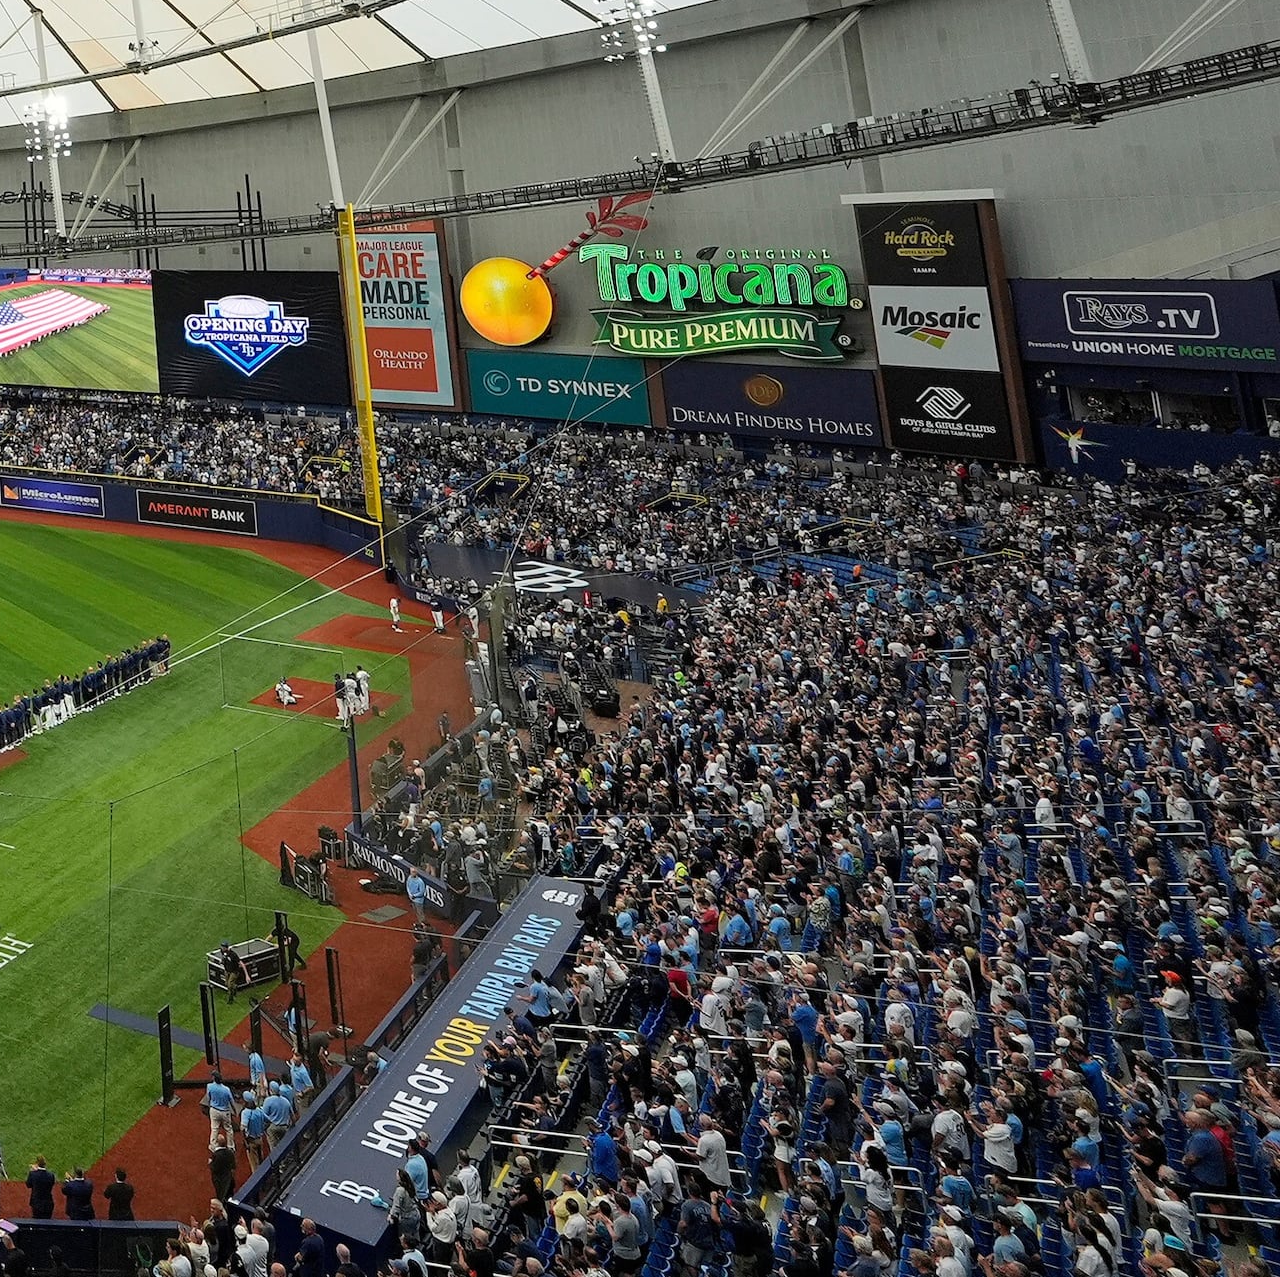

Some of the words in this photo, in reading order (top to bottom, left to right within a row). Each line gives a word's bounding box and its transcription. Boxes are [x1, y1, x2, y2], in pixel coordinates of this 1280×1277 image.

[356, 241, 387, 251] MAJOR
[390, 241, 423, 251] LEAGUE
[884, 230, 918, 245] Hard
[920, 230, 955, 246] Rock
[638, 249, 682, 260] THE
[726, 249, 832, 260] ORIGINAL
[358, 253, 427, 279] CARE
[578, 243, 849, 312] Tropicana
[361, 280, 430, 305] MADE
[363, 306, 431, 321] PERSONAL
[881, 305, 981, 329] Mosaic
[1156, 309, 1201, 329] .TV
[188, 317, 267, 332] OPENING
[270, 319, 305, 333] DAY
[610, 322, 681, 350] PURE
[685, 317, 816, 347] PREMIUM
[204, 333, 259, 342] TROPICANA
[261, 335, 288, 343] FIELD
[373, 348, 428, 360] ORLANDO
[1028, 340, 1061, 349] Presented
[1072, 340, 1124, 354] UNION
[1127, 343, 1175, 356] HOME
[1178, 344, 1277, 361] MORTGAGE
[380, 360, 424, 370] HEALTH
[516, 377, 542, 392] TD
[548, 379, 632, 399] SYNNEX
[671, 406, 731, 425] DREAM
[734, 411, 804, 431] FINDERS
[816, 417, 874, 437] HOMES
[900, 417, 925, 427] BOYS
[935, 421, 963, 431] GIRLS
[965, 424, 996, 434] CLUBS
[921, 427, 949, 436] GREATER
[22, 488, 100, 504] MicroLumen
[148, 501, 210, 519] AMERANT
[211, 508, 246, 523] BANK
[520, 913, 564, 948] RAYS
[494, 941, 541, 974] BAY
[459, 971, 518, 1021] TAMPA
[425, 1016, 491, 1067] YOUR
[408, 1062, 455, 1095] OF
[361, 1090, 438, 1158] HOME
[320, 1178, 379, 1204] TB
